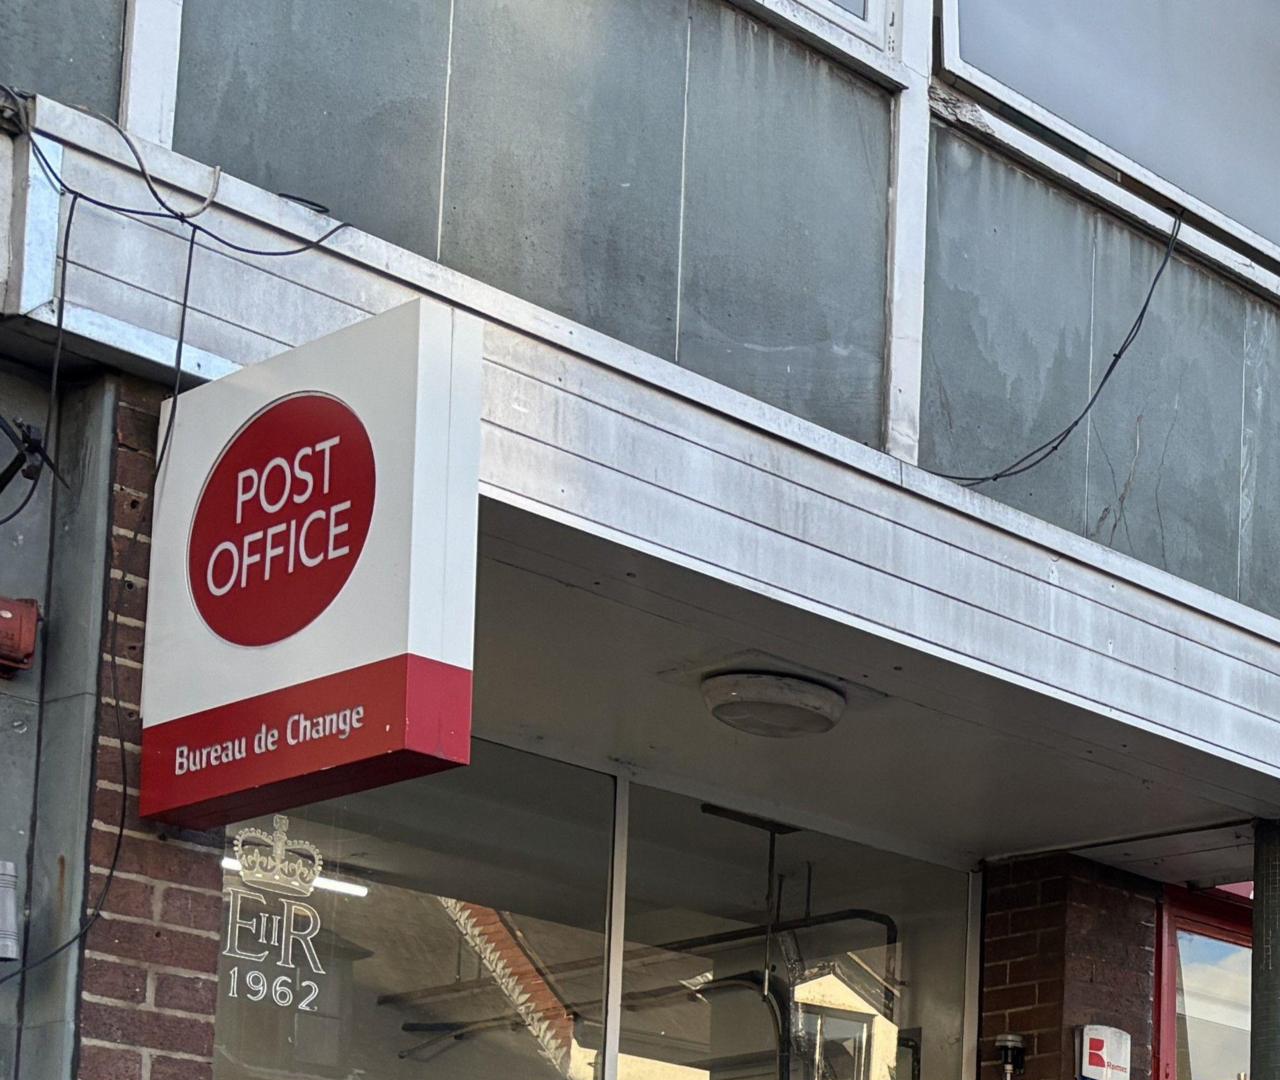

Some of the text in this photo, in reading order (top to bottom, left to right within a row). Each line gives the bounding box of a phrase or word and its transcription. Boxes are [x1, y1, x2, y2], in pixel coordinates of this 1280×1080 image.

[236, 435, 340, 523] POST
[207, 500, 351, 596] OFFICE
[175, 706, 364, 775] Bureau de Change
[229, 966, 320, 1011] 1962
